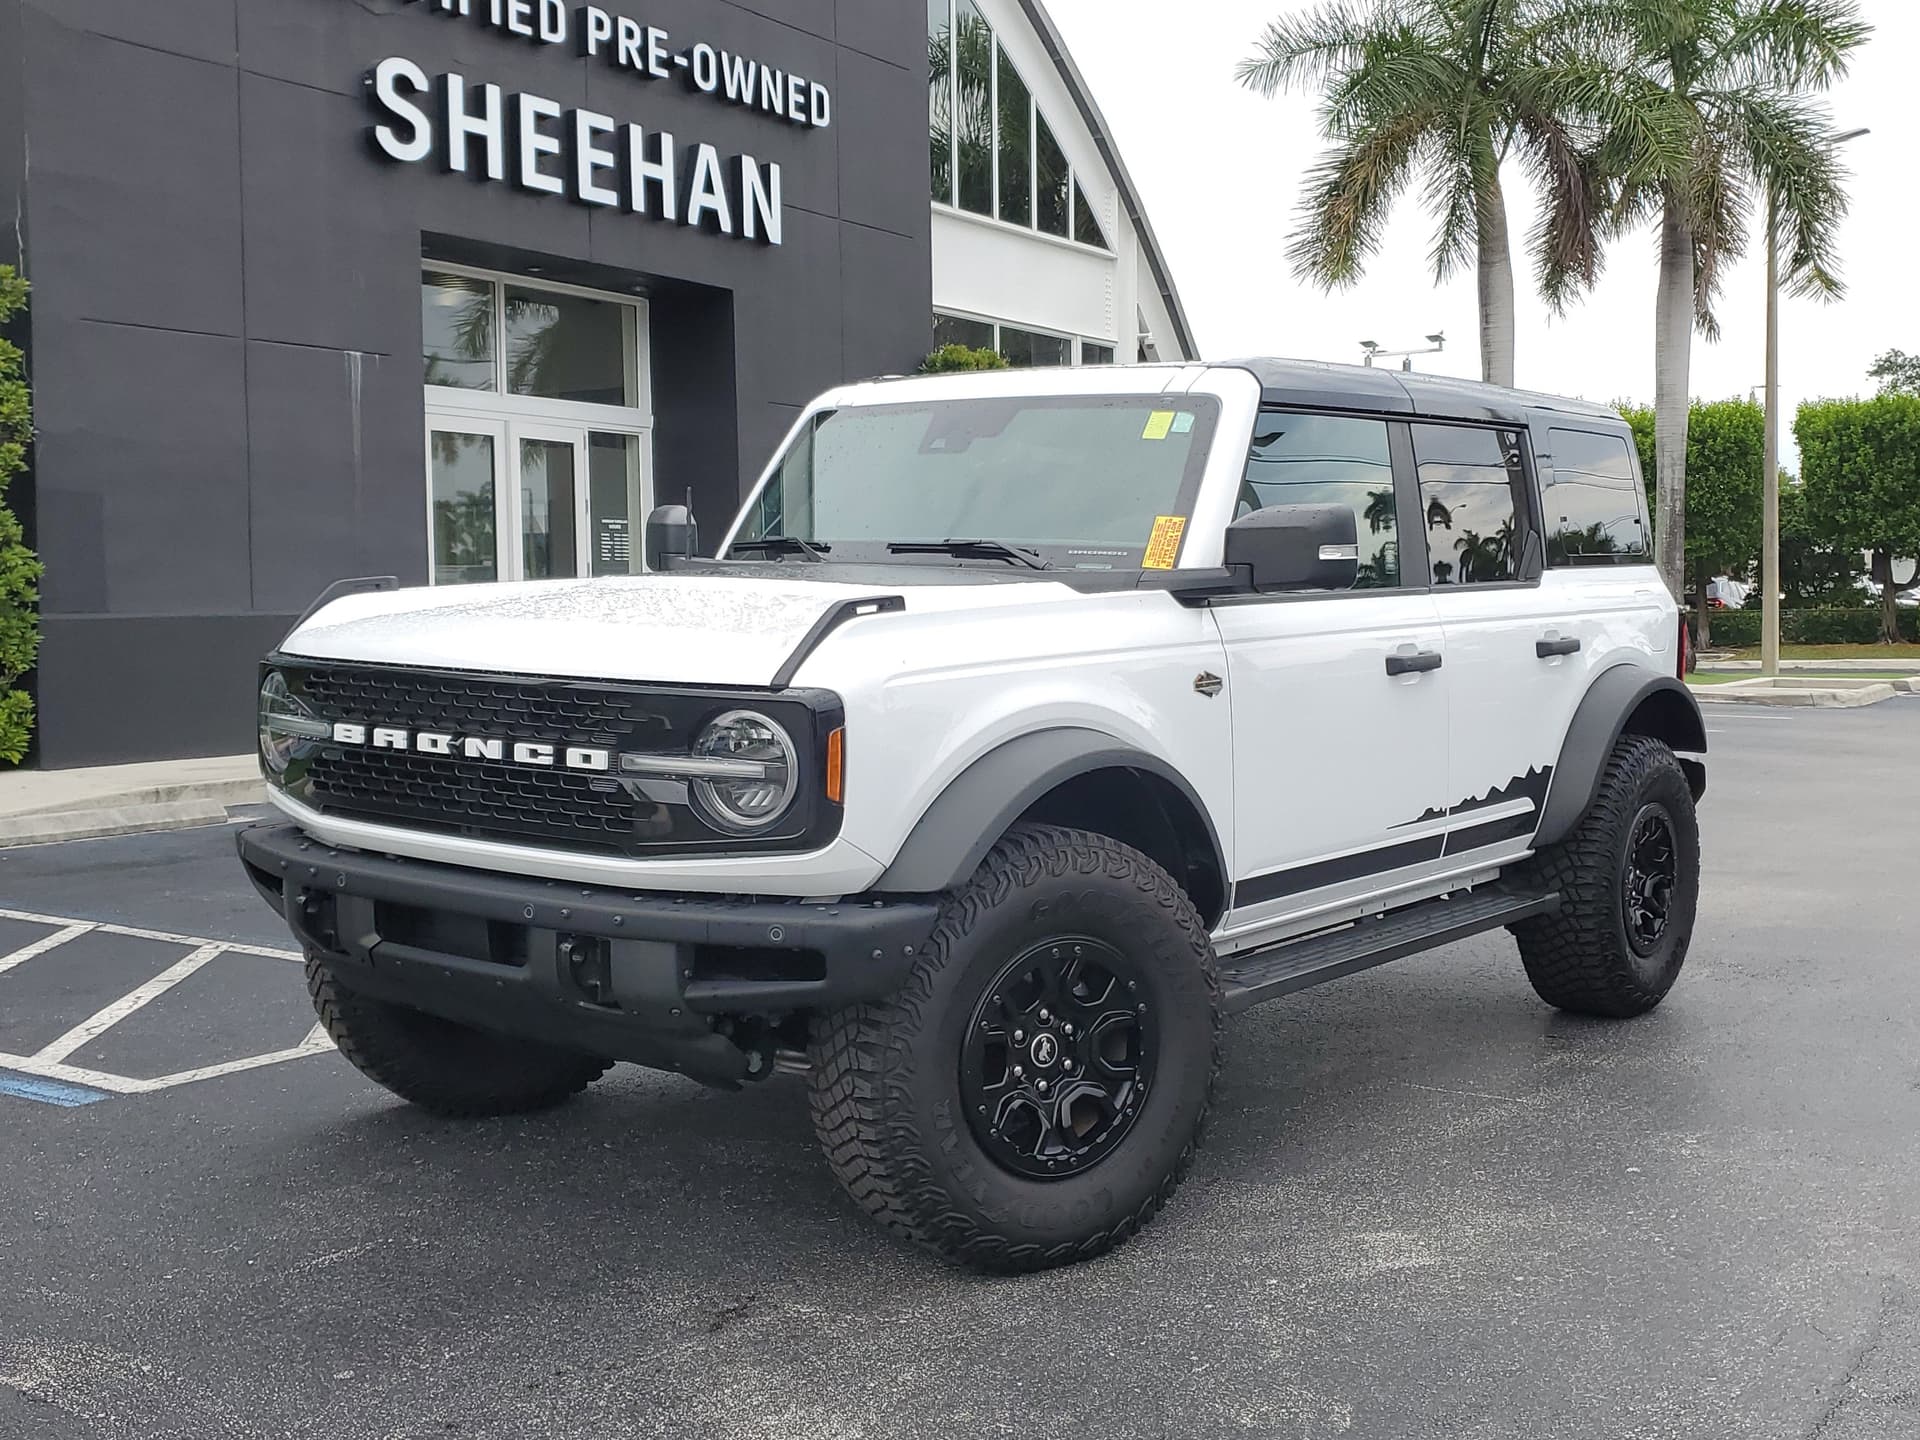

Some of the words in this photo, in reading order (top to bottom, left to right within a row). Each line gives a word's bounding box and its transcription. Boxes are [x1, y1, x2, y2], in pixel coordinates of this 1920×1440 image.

[587, 6, 831, 128] PRE-OWNED
[374, 56, 782, 245] SHEEHAN
[333, 723, 609, 770] BRONCO
